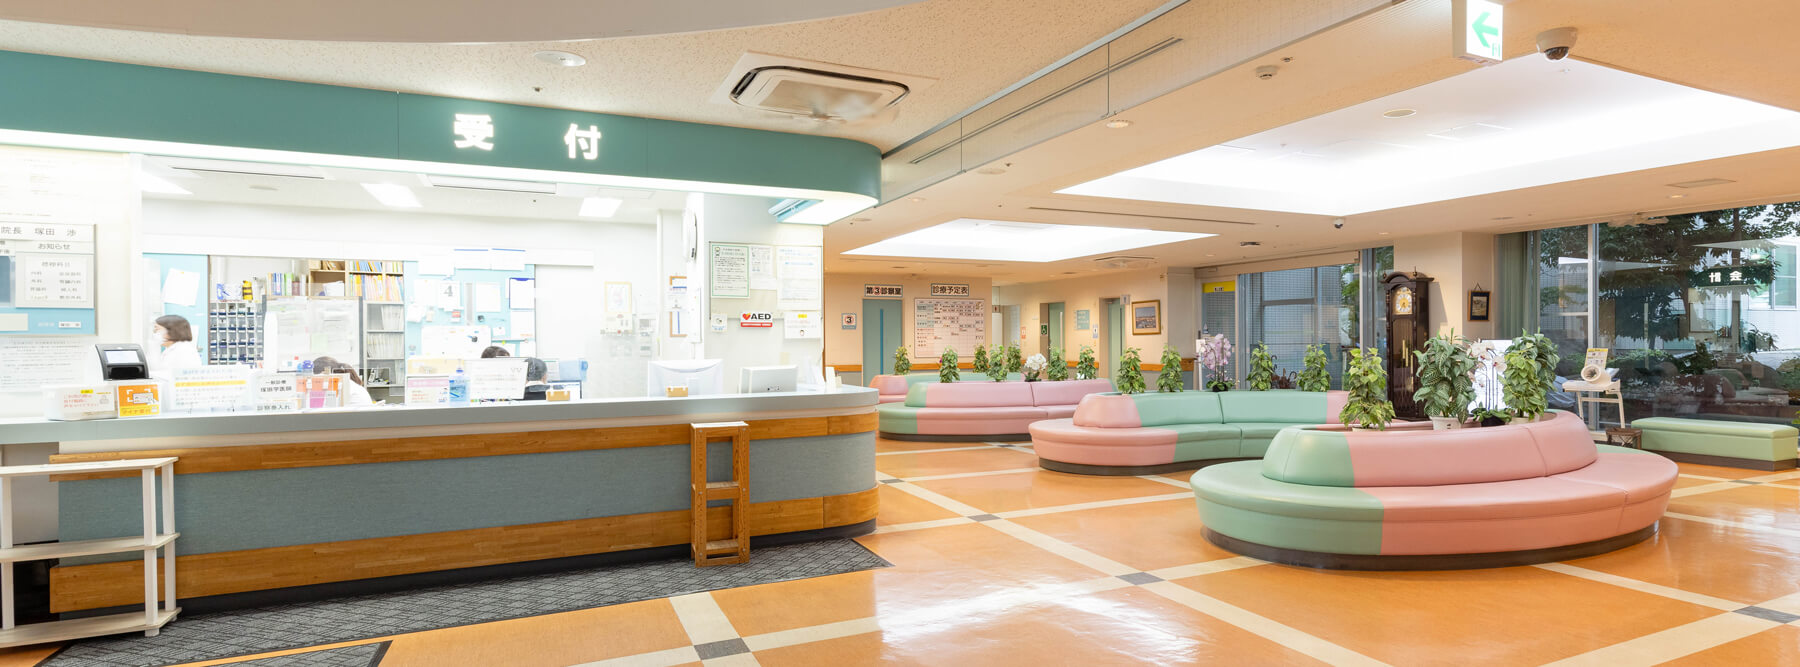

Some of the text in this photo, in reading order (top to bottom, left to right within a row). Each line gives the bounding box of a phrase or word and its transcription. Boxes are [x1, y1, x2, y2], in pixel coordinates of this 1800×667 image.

[453, 113, 601, 160] 受付
[443, 285, 453, 297] 4
[932, 285, 968, 294] 診療予定表
[846, 316, 852, 324] 3
